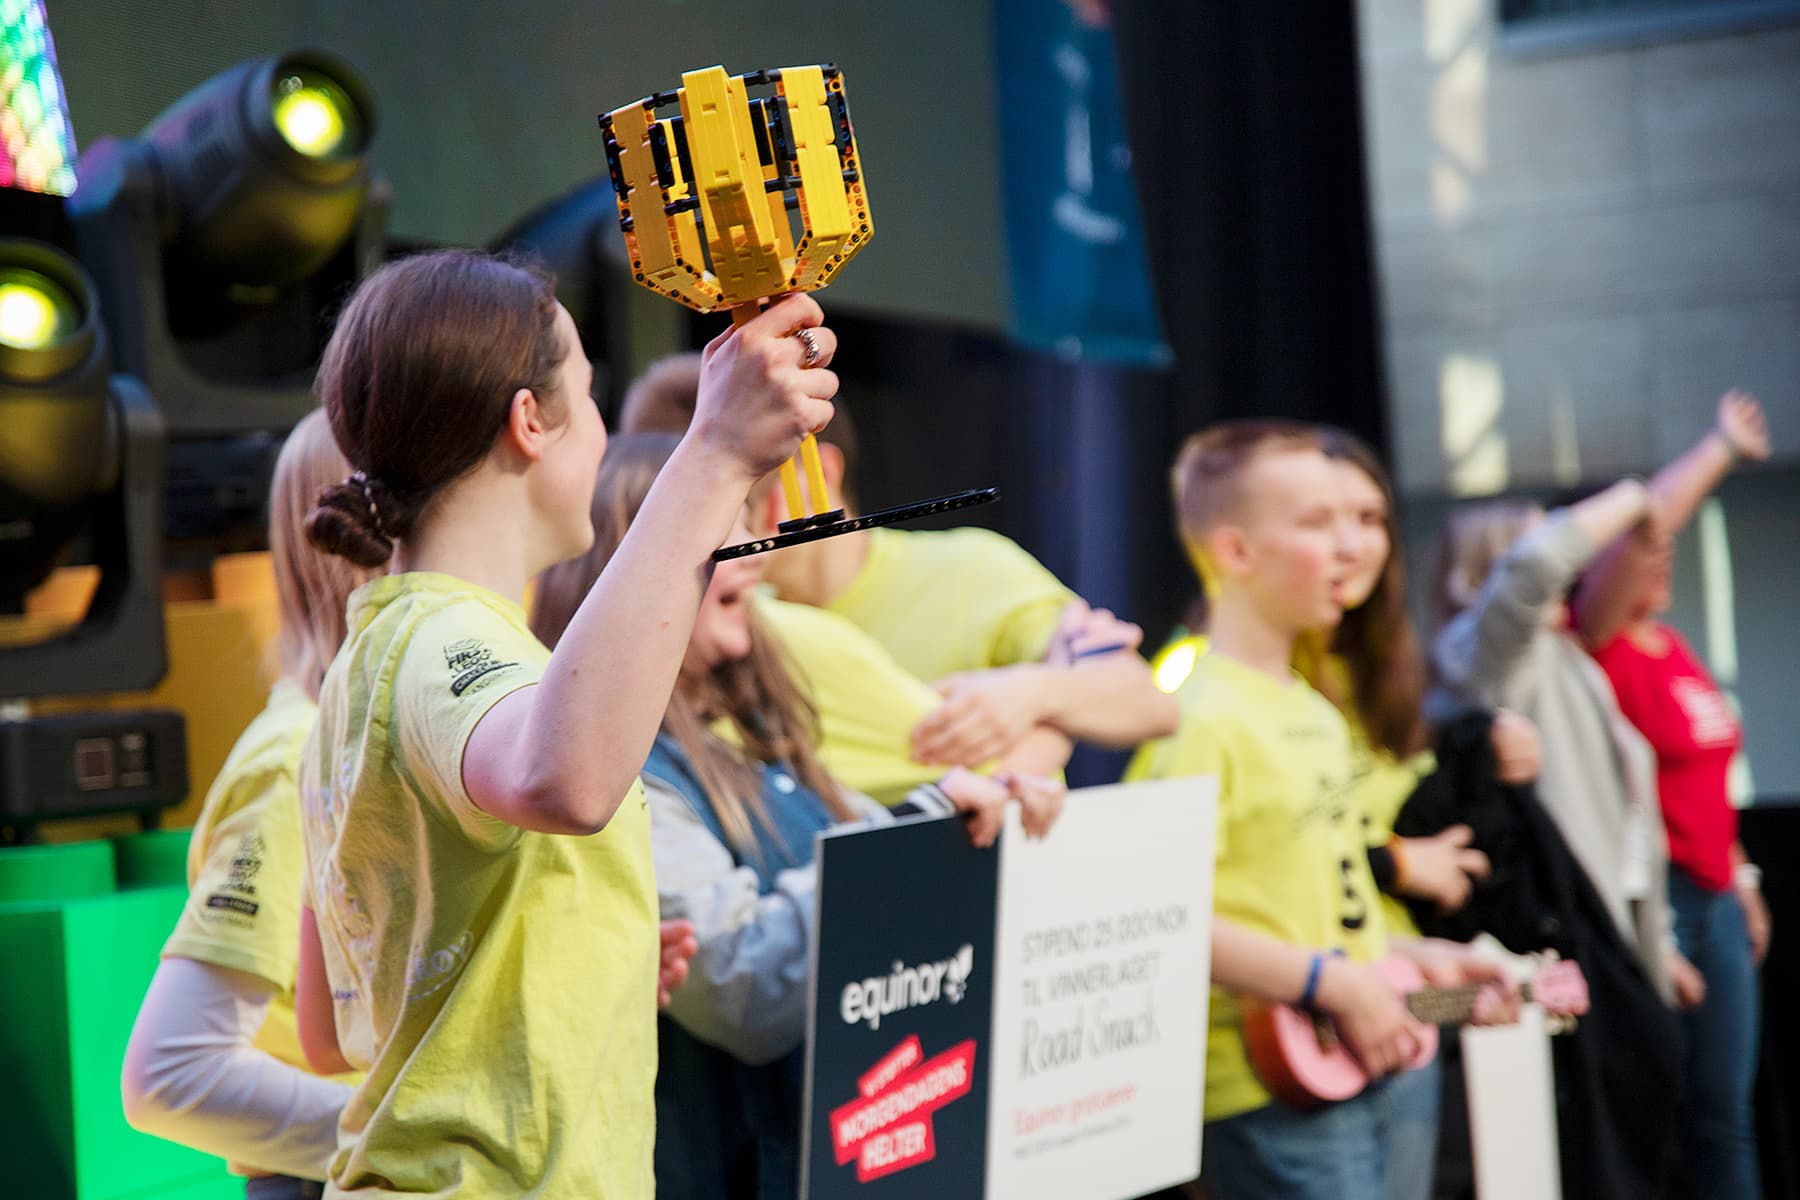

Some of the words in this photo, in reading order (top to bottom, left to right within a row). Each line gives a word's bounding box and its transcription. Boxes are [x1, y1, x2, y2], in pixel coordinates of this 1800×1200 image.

[1021, 921, 1089, 964] STIPEND
[1093, 918, 1113, 949] 25
[1117, 910, 1153, 942] 000
[1155, 904, 1190, 935] NOK
[841, 959, 947, 1031] equinor
[1018, 1002, 1084, 1080] Road
[838, 1056, 968, 1148] MORGENDAGENS
[862, 1120, 928, 1172] HELTER
